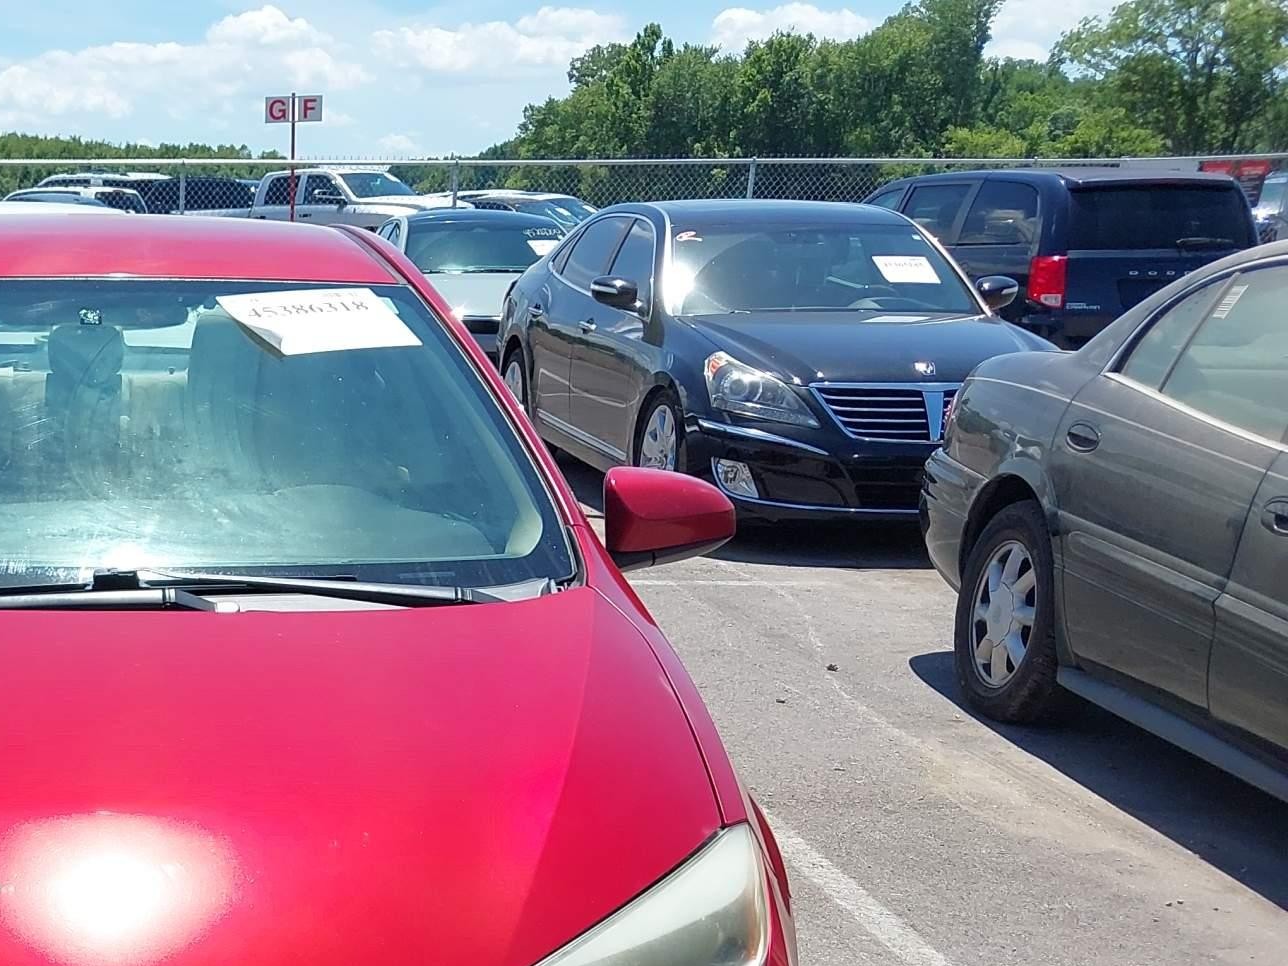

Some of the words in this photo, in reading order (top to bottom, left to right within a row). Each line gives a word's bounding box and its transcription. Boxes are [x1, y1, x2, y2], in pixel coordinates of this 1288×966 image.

[268, 99, 287, 121] G
[303, 98, 318, 120] F
[248, 300, 369, 318] 45386318
